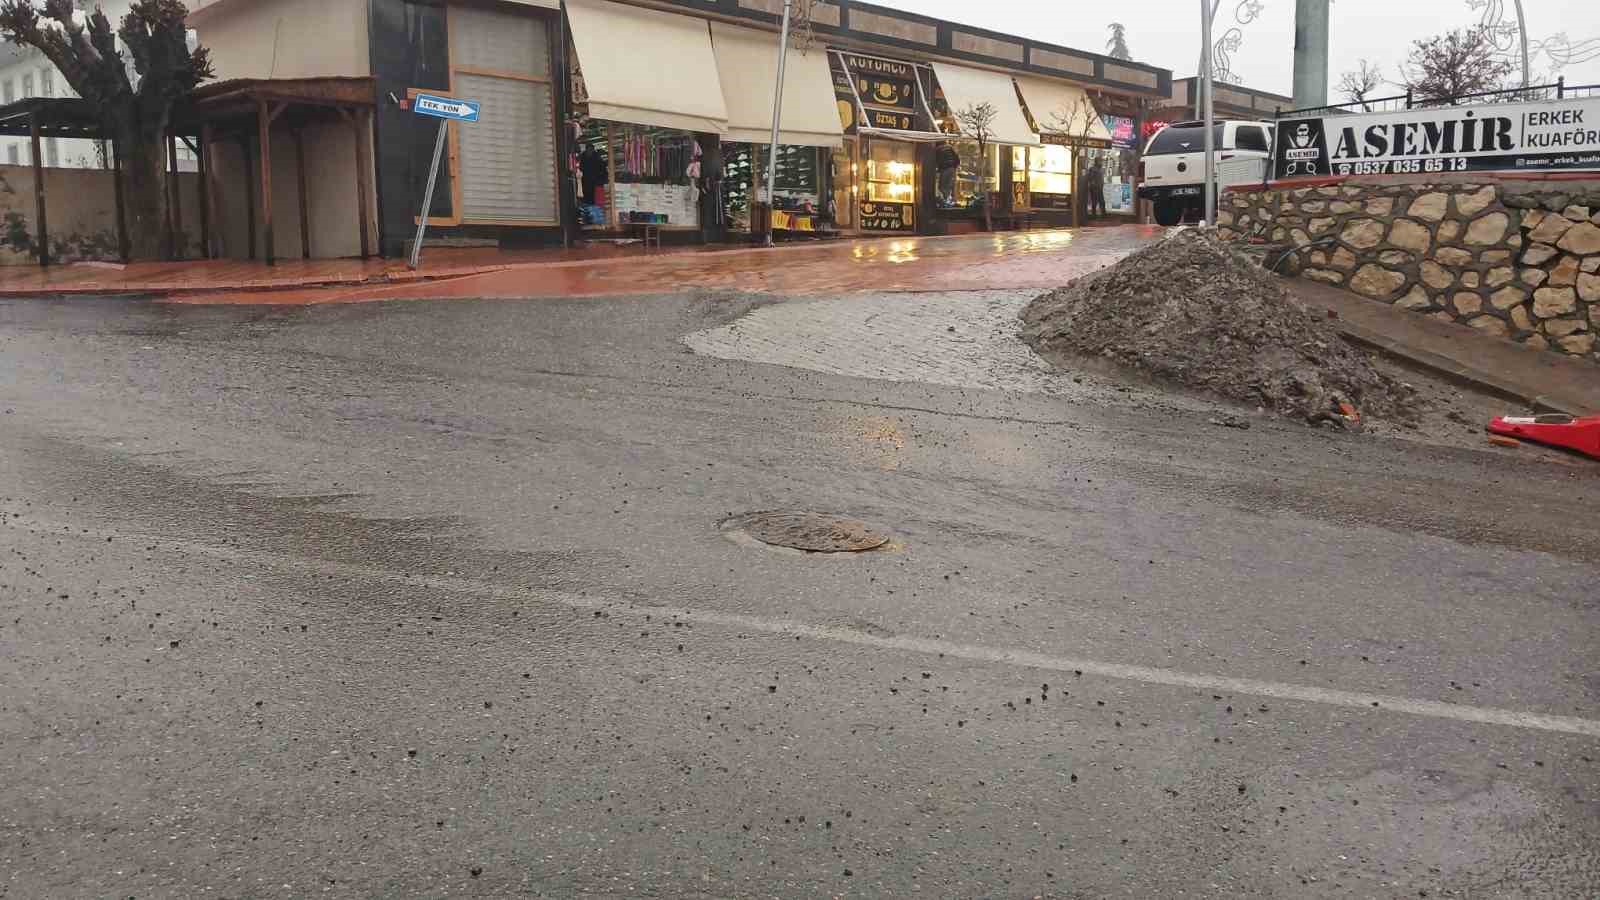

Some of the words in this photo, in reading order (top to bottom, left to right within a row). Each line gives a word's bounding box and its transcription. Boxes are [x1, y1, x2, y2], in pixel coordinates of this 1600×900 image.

[423, 101, 438, 109] TEK
[1528, 109, 1584, 126] ERKEK
[1331, 110, 1516, 159] ASEMİR
[1527, 128, 1600, 147] KUAFÖR
[1355, 161, 1389, 175] 0537
[1393, 159, 1420, 173] 035
[1424, 158, 1443, 172] 65
[1449, 157, 1467, 171] 13
